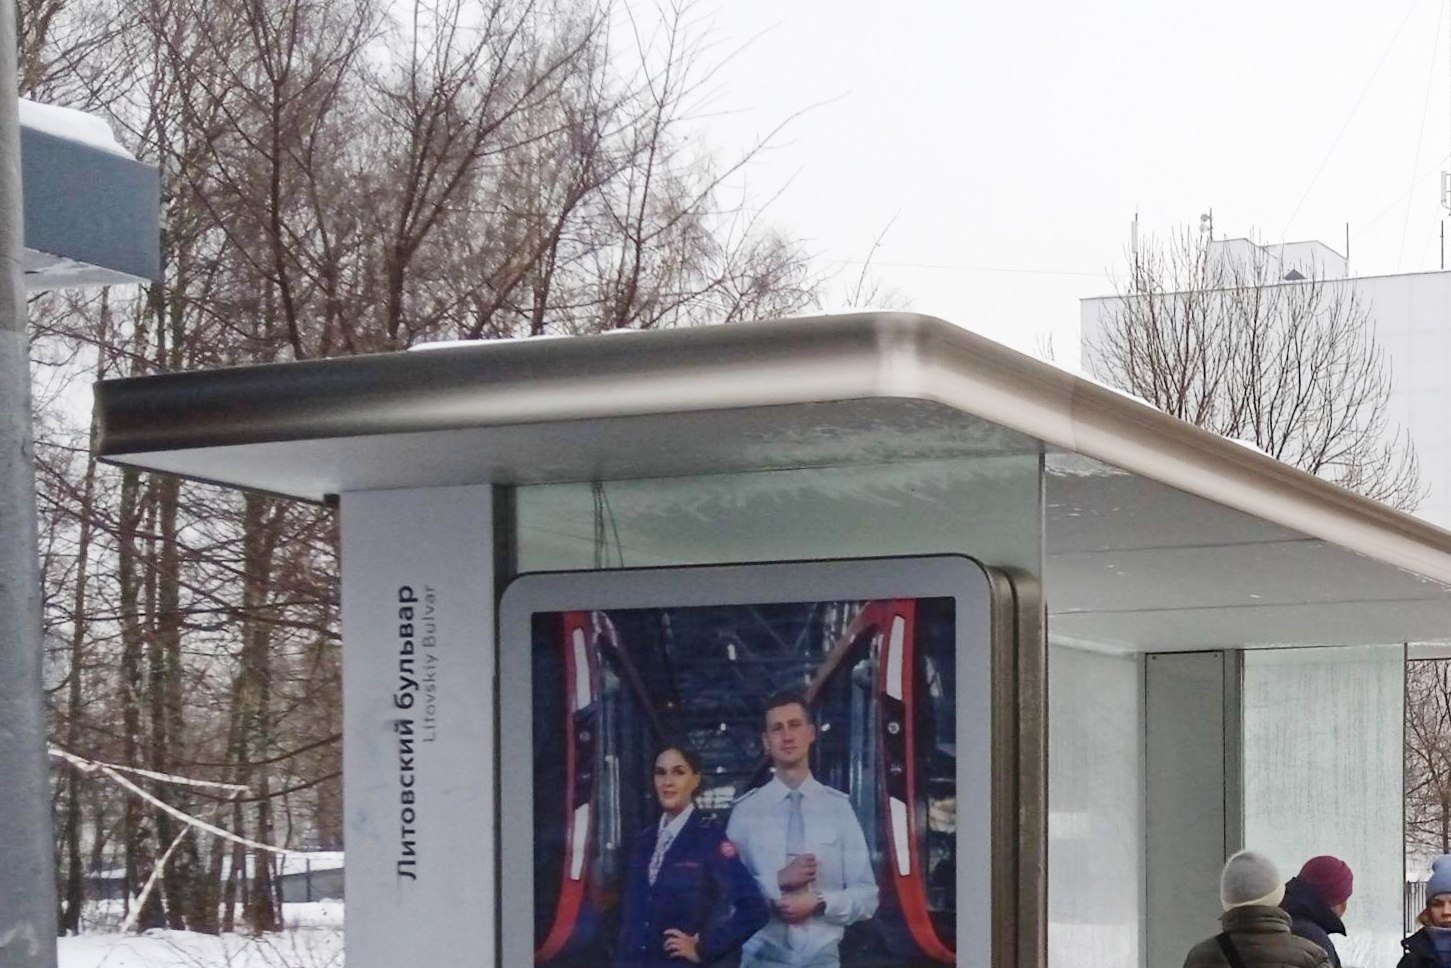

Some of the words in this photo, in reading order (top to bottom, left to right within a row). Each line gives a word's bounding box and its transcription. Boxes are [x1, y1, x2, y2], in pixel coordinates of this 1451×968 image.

[394, 584, 419, 710] бульвар
[421, 584, 437, 647] Bulvar
[422, 653, 440, 743] Litovskiy
[394, 719, 417, 881] Литовский
